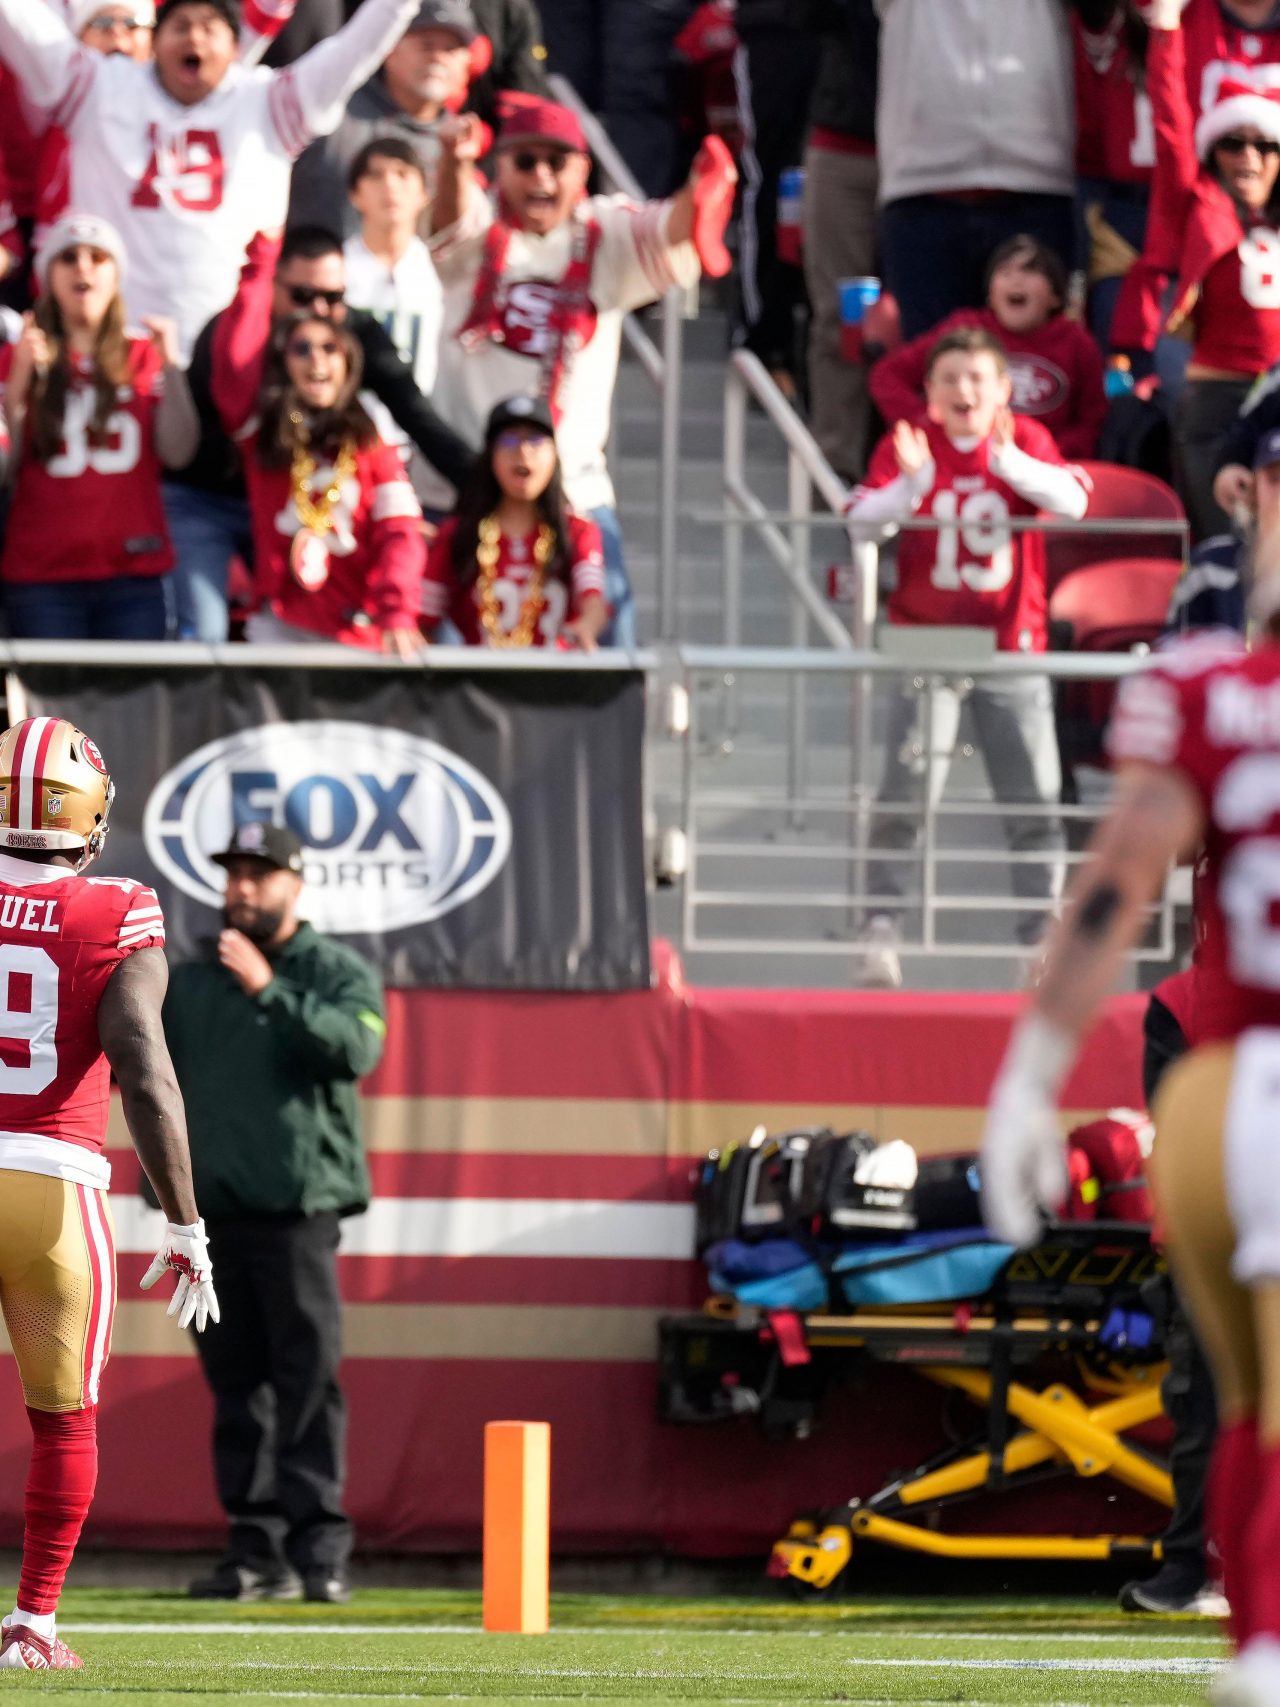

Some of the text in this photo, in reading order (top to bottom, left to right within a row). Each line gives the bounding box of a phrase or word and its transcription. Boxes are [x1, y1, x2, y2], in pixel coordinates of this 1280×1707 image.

[931, 488, 1013, 593] 19
[230, 771, 422, 852] FOX
[300, 860, 431, 888] ORTS
